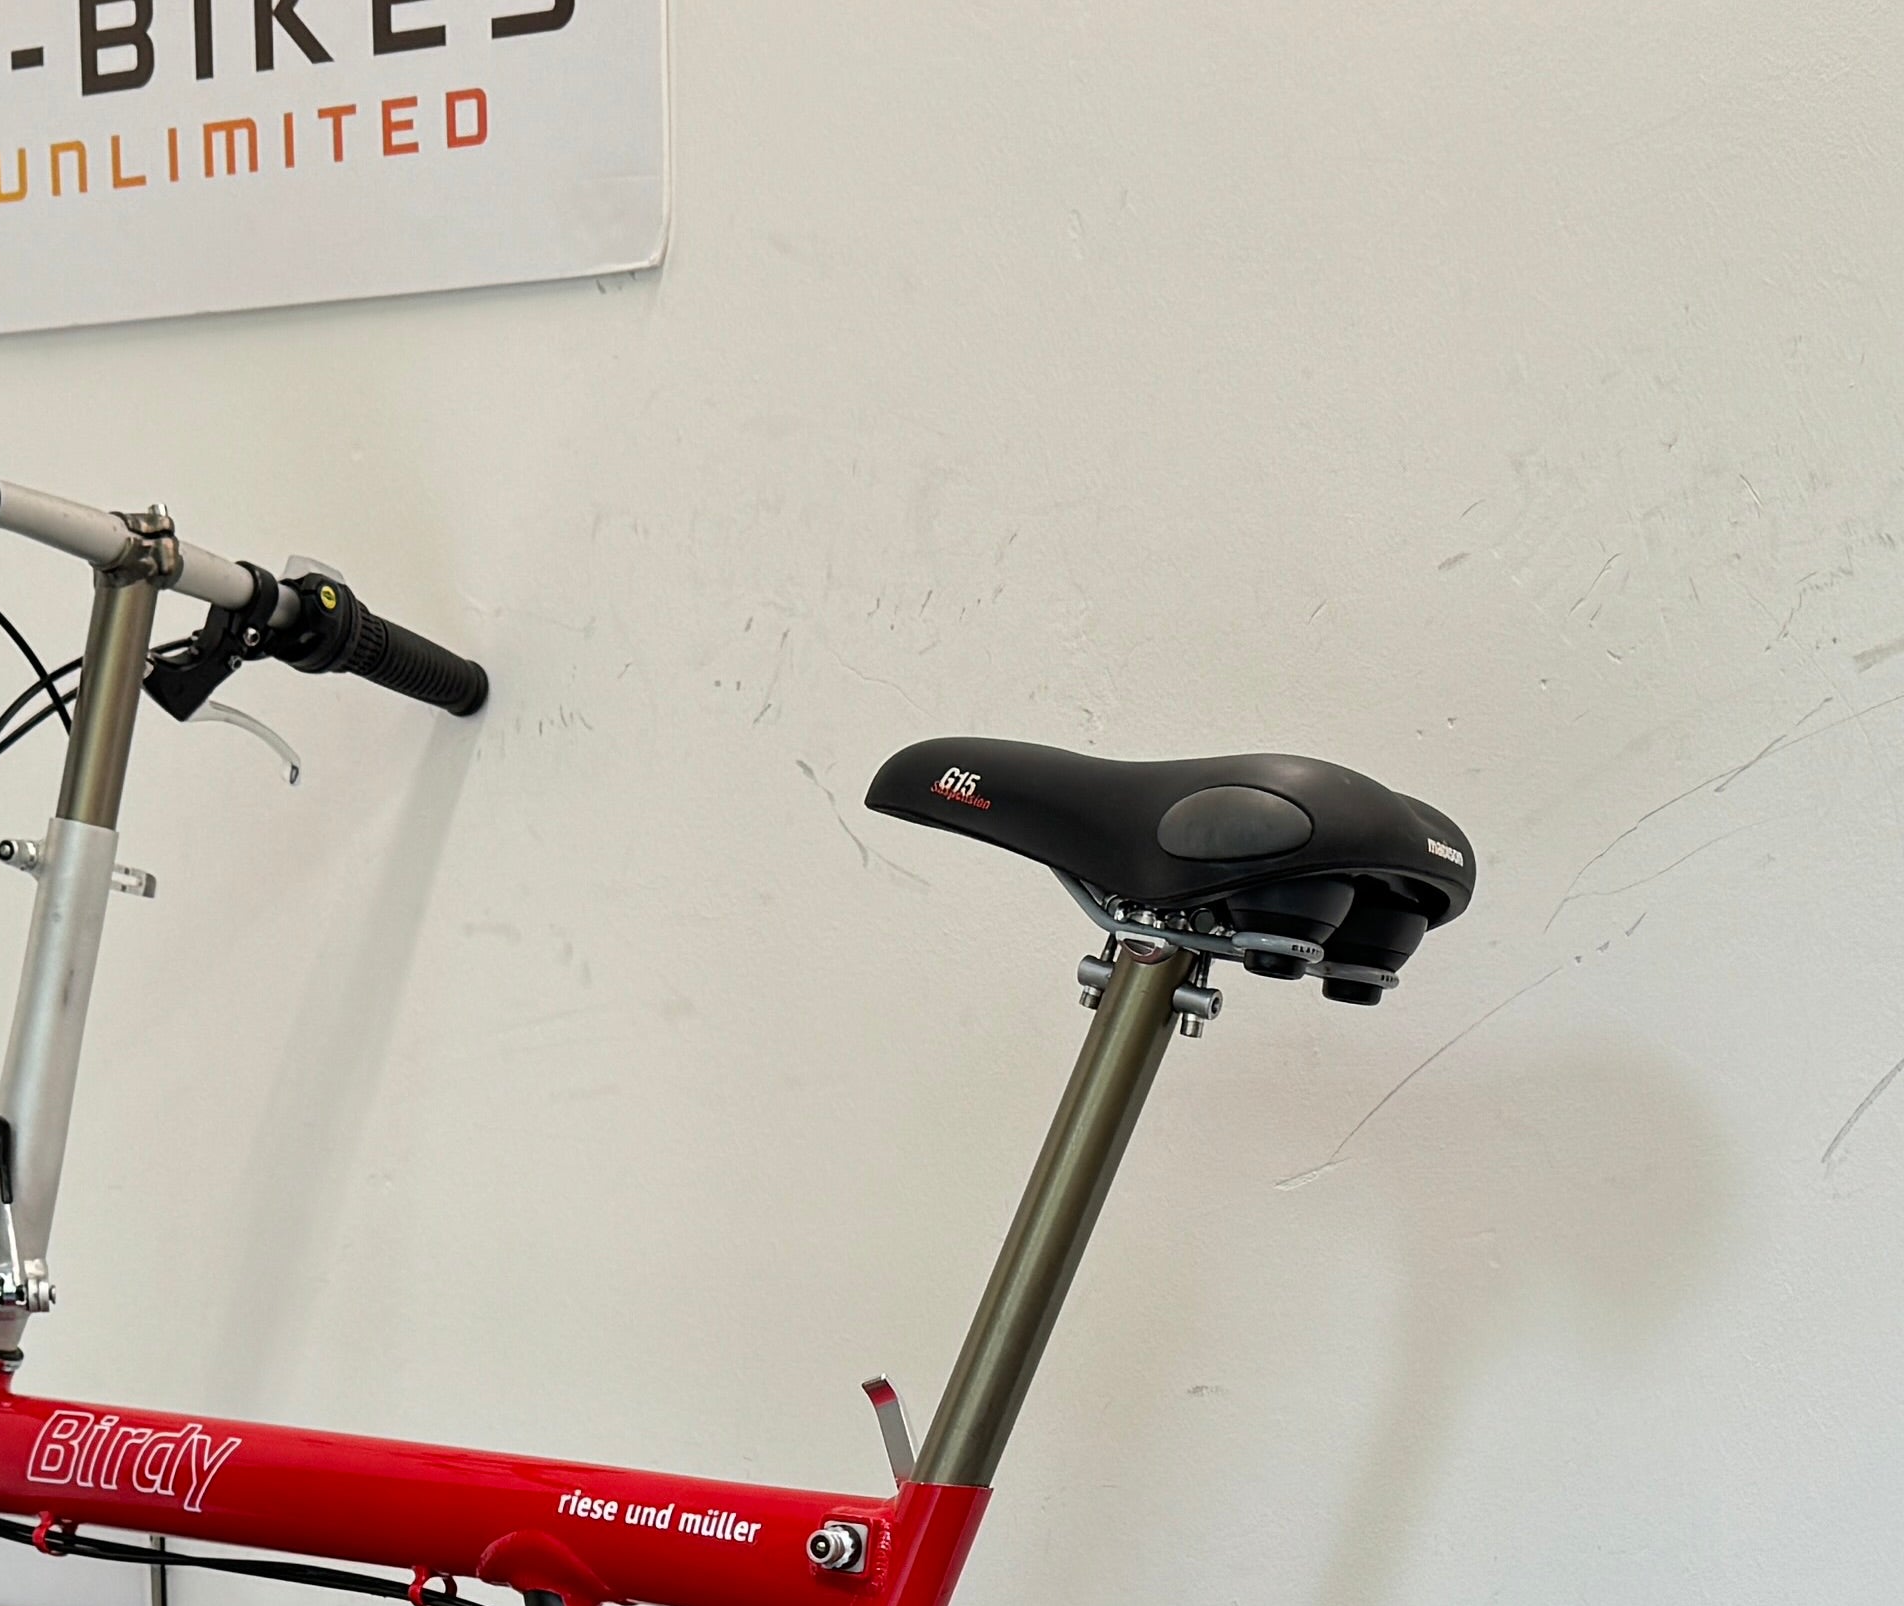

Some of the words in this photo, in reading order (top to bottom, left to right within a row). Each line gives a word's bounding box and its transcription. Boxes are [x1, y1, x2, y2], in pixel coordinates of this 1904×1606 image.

[939, 767, 981, 796] G15
[27, 1410, 242, 1512] Birdy
[558, 1490, 618, 1521] riese
[626, 1503, 676, 1530] und
[679, 1510, 762, 1543] müller
